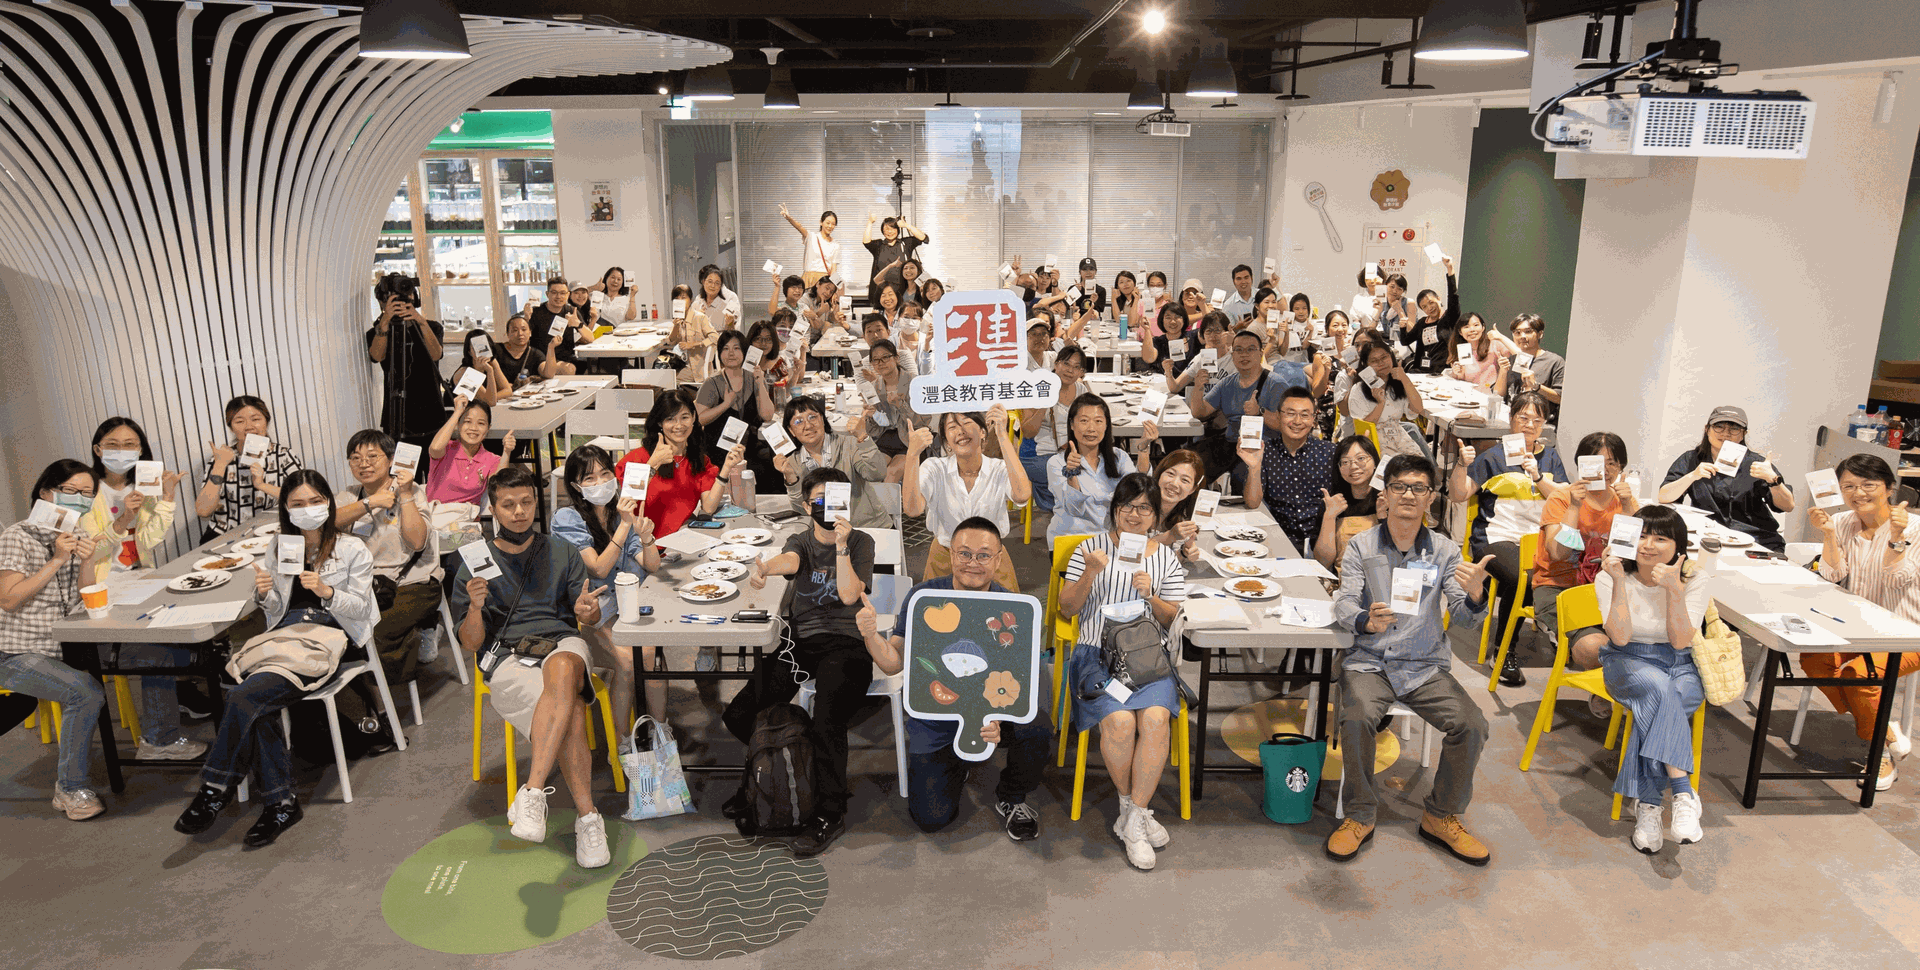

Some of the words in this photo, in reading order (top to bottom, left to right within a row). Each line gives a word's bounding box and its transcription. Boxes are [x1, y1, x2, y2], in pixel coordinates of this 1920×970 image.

[921, 379, 1052, 404] 灃食教育基金會
[811, 570, 827, 584] REX
